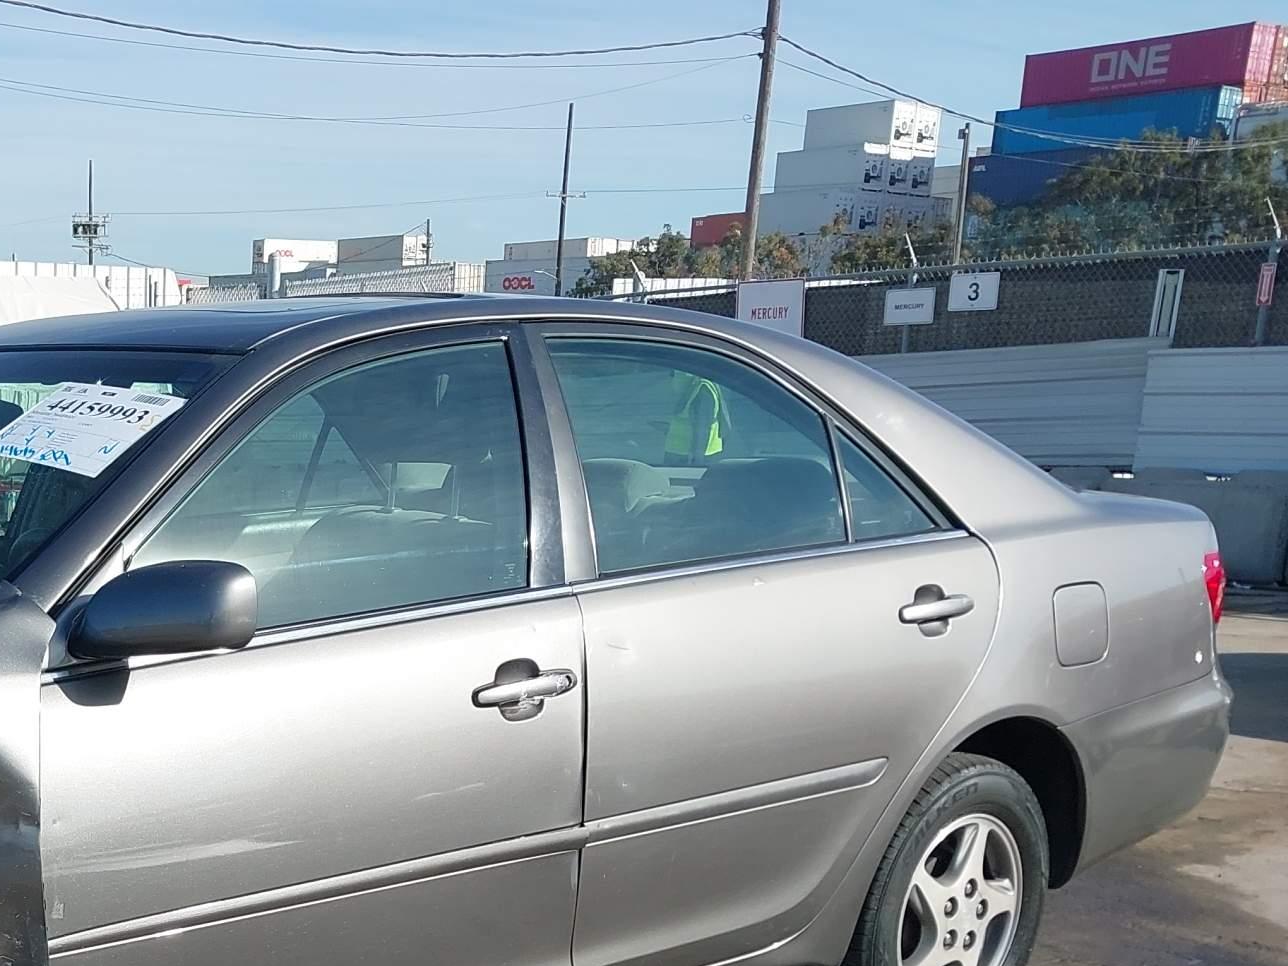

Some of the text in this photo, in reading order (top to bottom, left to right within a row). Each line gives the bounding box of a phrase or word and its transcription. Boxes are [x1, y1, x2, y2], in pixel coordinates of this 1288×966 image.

[1091, 44, 1171, 83] ONE
[503, 276, 534, 290] OOCL
[968, 282, 980, 301] 3
[751, 306, 789, 320] MERCURY
[47, 398, 150, 424] 44159993
